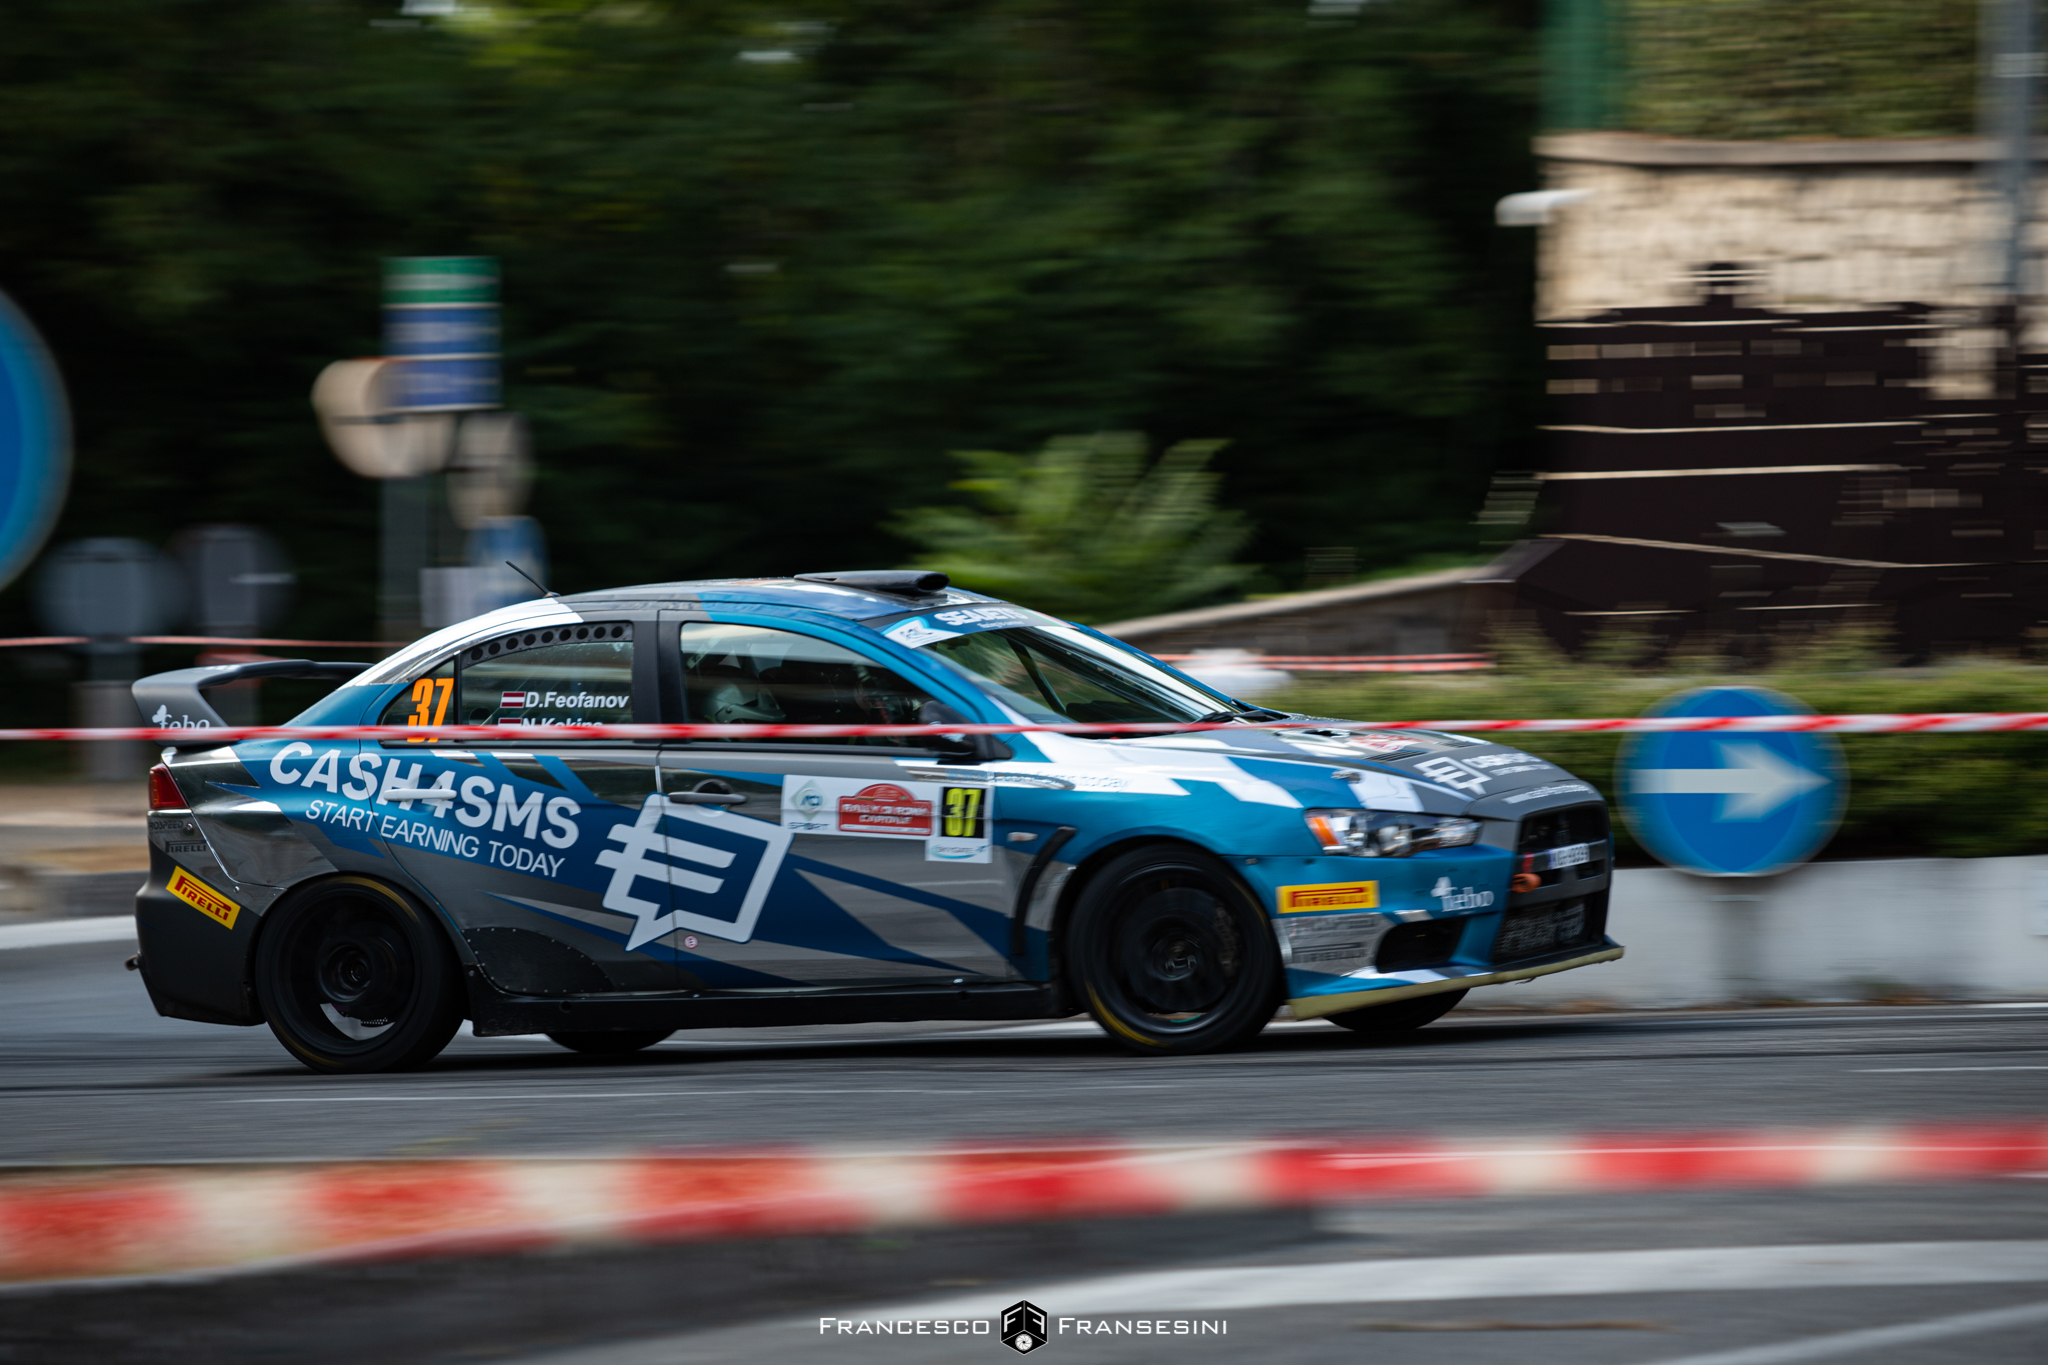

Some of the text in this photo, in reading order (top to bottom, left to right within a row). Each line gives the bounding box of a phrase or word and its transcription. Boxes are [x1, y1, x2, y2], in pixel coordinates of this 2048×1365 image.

[407, 677, 454, 743] 37
[525, 691, 630, 708] D.Feofanov
[270, 742, 582, 849] CASH4SMS
[945, 788, 982, 837] 37
[165, 840, 208, 853] PIRELLI
[306, 800, 565, 877] START EARNING TODAY
[174, 875, 232, 921] PIRELLI
